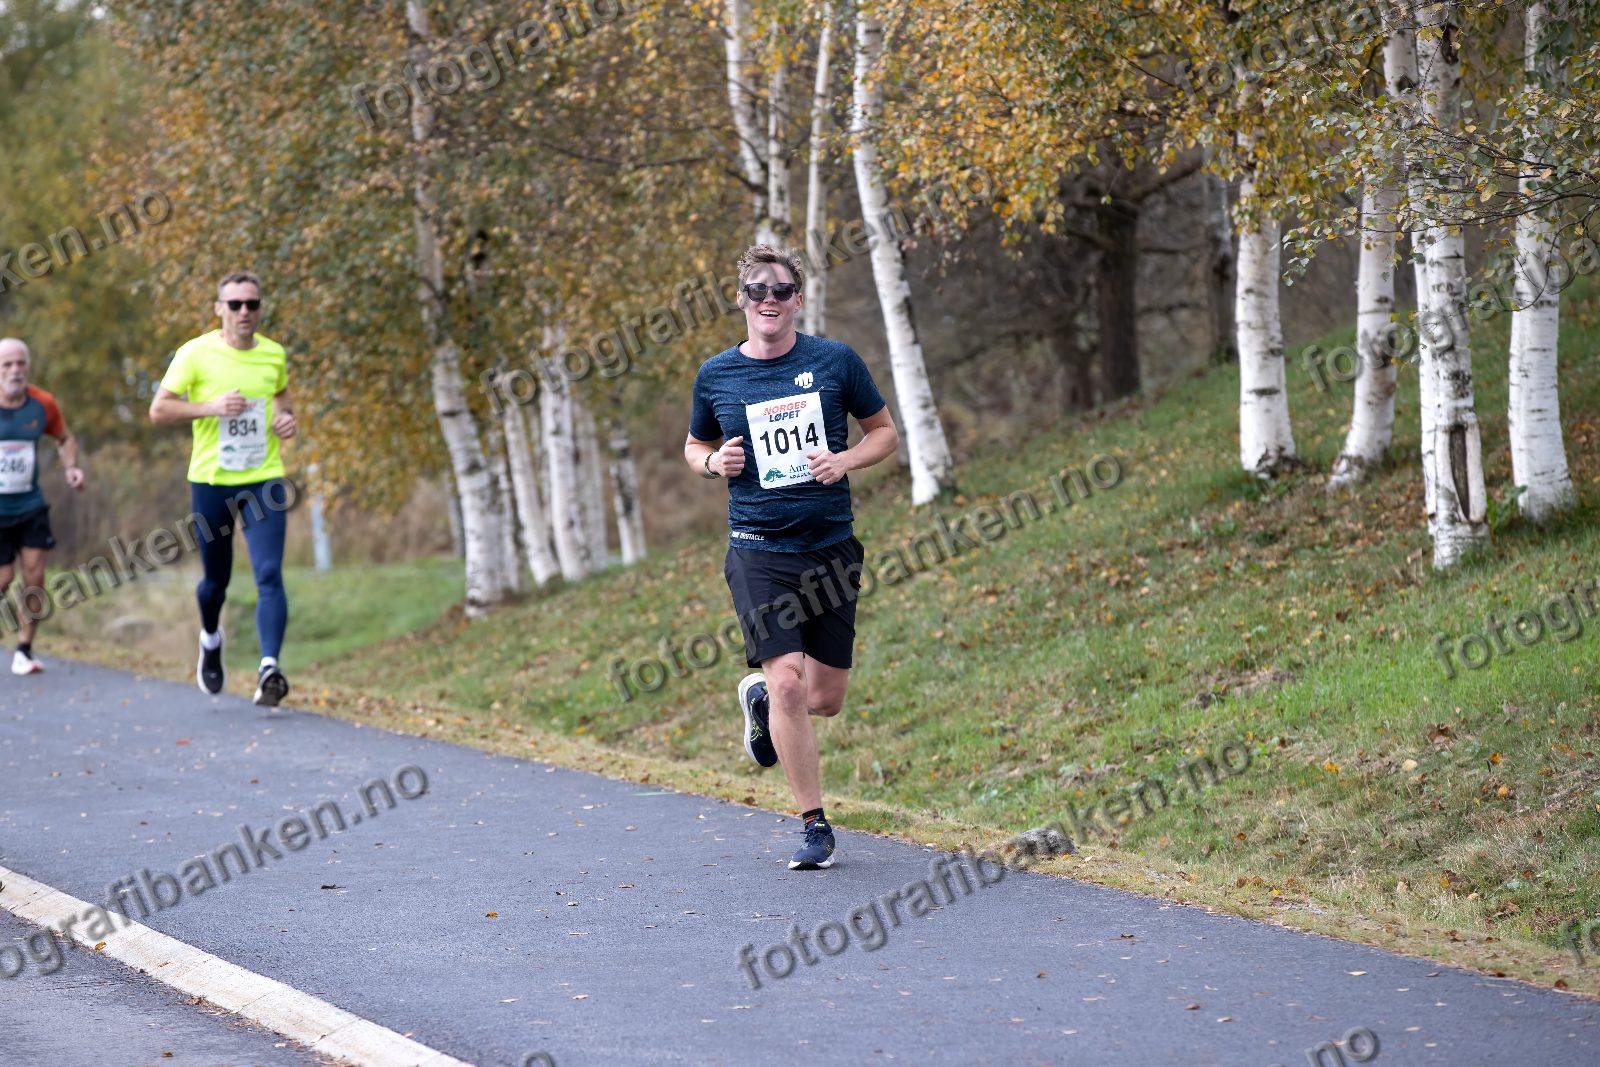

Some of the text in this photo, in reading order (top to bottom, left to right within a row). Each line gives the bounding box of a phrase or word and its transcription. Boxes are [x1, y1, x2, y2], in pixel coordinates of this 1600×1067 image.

[763, 401, 807, 416] NORGES
[769, 410, 801, 422] LØPET
[229, 419, 257, 436] 834
[760, 423, 819, 456] 1014
